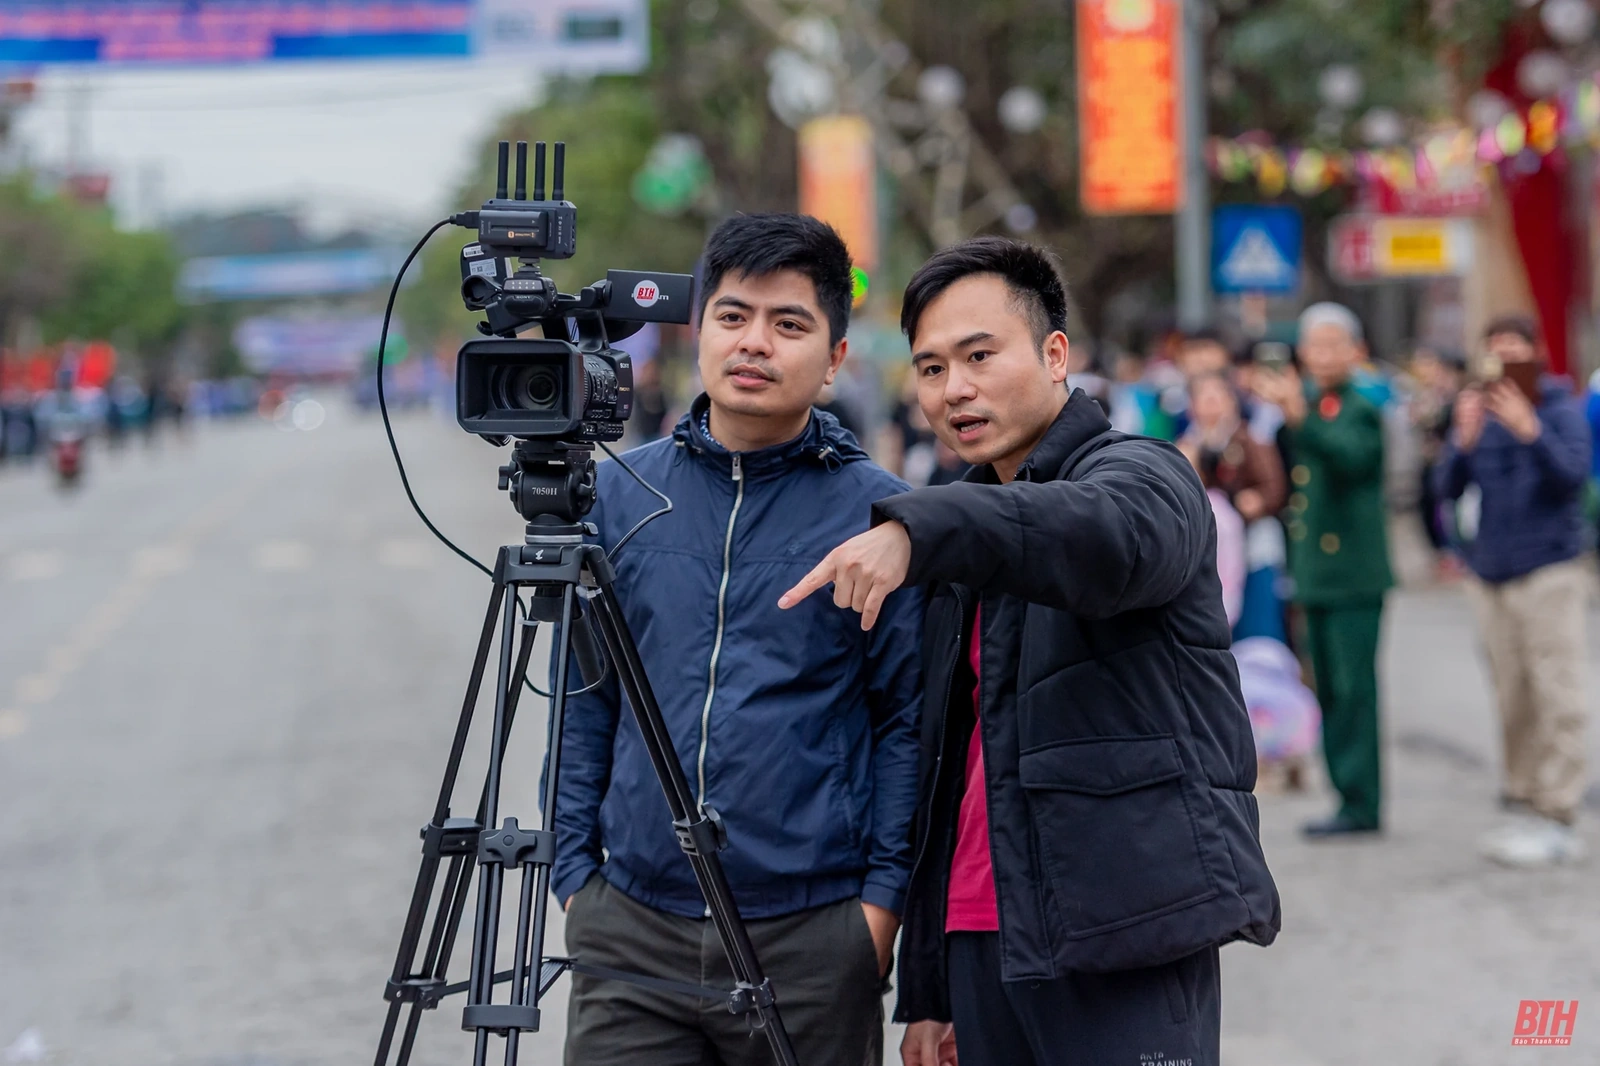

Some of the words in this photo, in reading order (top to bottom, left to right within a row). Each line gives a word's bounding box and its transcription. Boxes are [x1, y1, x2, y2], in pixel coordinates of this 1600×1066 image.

[638, 287, 656, 297] BTH
[531, 487, 558, 496] 7050H
[1141, 1058, 1192, 1066] TRAINING
